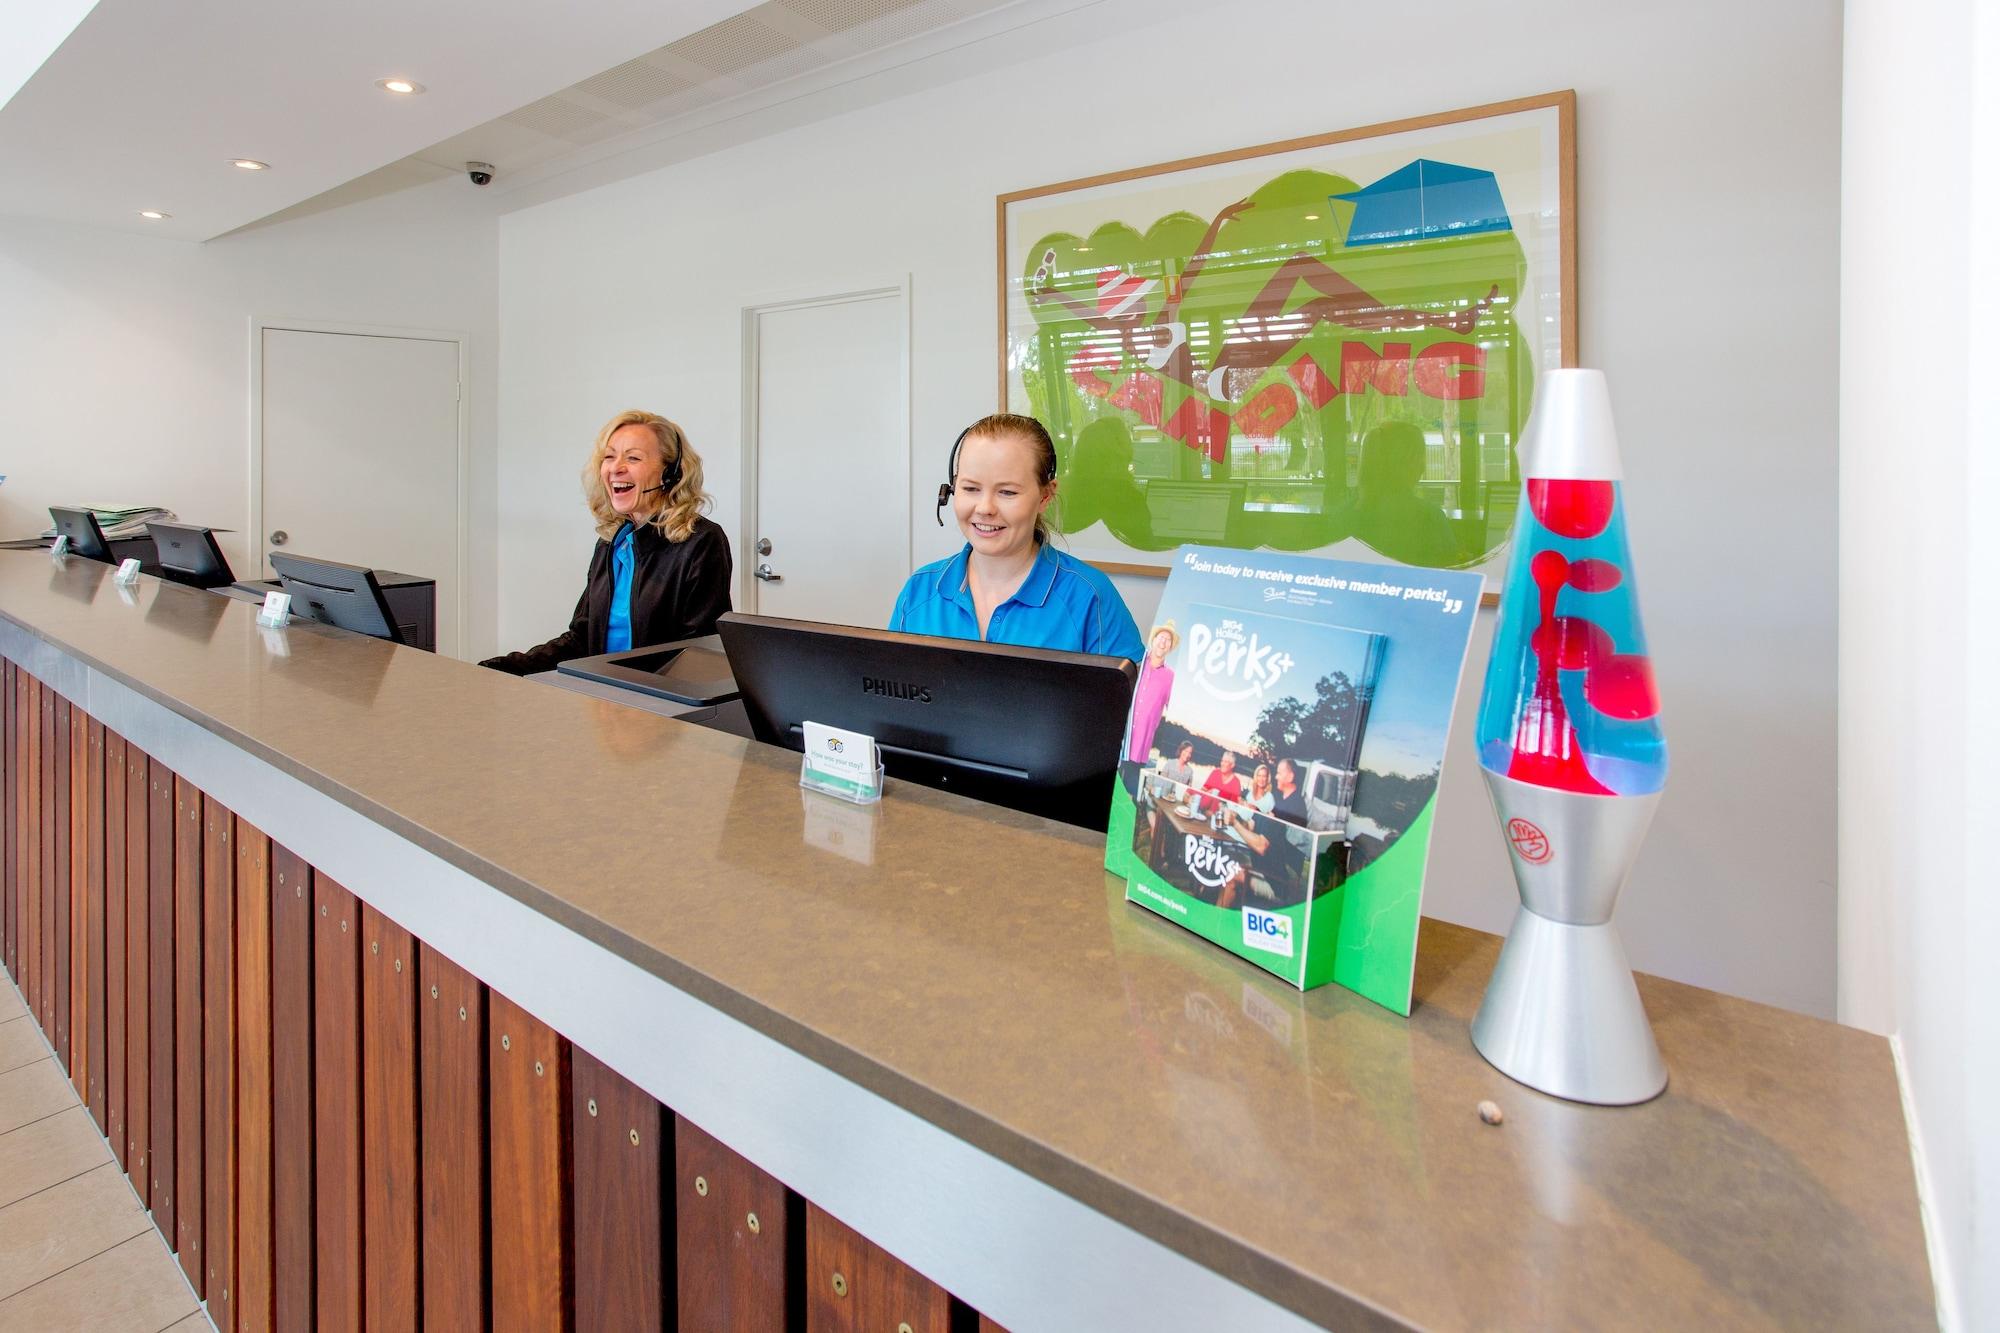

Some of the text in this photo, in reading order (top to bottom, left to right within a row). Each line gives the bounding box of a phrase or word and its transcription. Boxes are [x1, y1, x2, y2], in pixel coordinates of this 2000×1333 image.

[1071, 341, 1487, 464] CAMPING
[1212, 563, 1241, 578] today
[1242, 566, 1254, 577] to
[1255, 569, 1293, 583] receive
[1295, 574, 1347, 590] exclusive
[1348, 580, 1402, 597] member
[862, 676, 932, 703] PHILIPS
